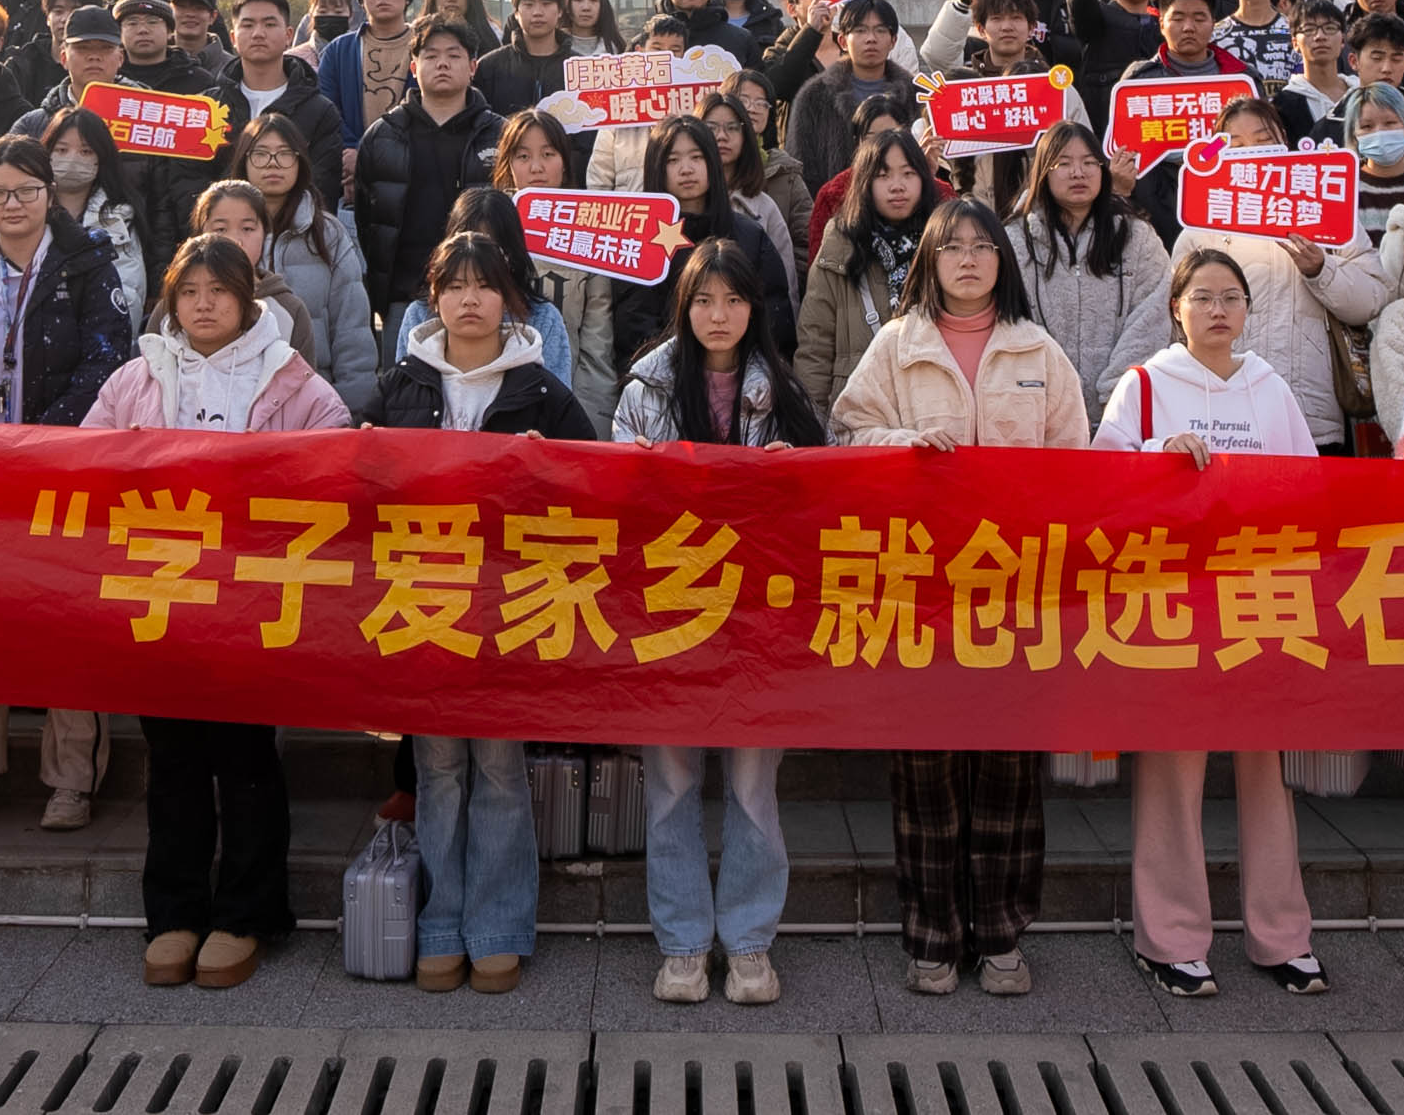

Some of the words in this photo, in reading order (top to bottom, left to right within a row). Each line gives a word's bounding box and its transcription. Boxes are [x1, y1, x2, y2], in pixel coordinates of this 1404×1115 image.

[566, 53, 673, 91] 归来黄石
[960, 83, 1028, 107] 欢聚黄石
[1126, 92, 1222, 118] 青春无悔
[117, 97, 210, 128] 青春有梦
[103, 117, 177, 149] 石启航
[1140, 118, 1215, 142] 黄石扎
[1229, 163, 1348, 203] 魅力黄石
[527, 199, 651, 234] 黄石就业行
[1206, 188, 1323, 227] 青春绘梦
[524, 226, 643, 270] 一起赢未来
[1188, 419, 1209, 431] The
[1211, 420, 1251, 432] Pursuit
